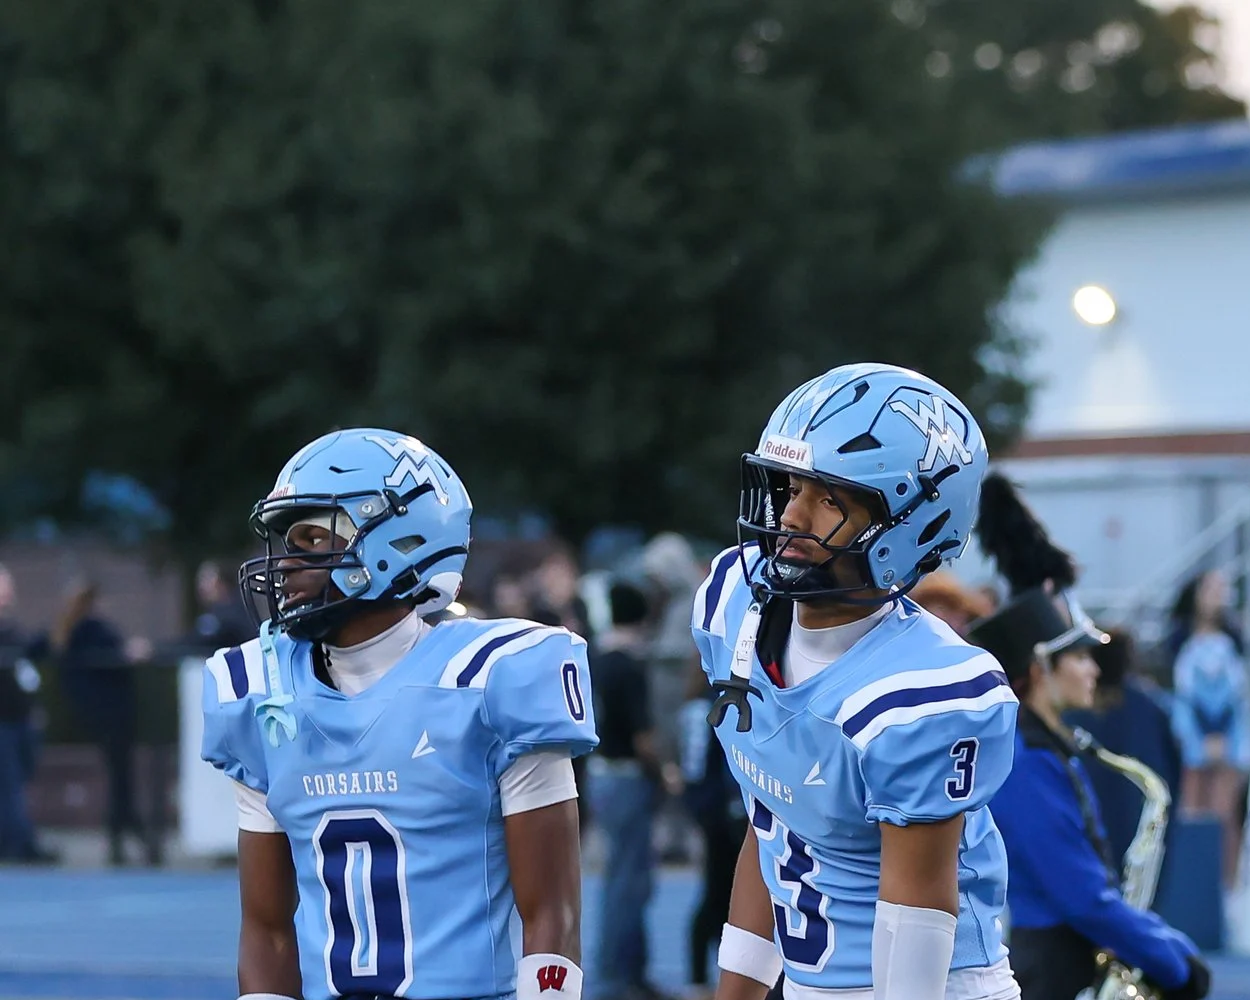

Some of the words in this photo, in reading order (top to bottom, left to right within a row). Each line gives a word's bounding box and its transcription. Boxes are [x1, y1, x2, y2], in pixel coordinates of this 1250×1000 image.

[764, 440, 808, 462] Riddell
[560, 660, 585, 720] 0
[302, 770, 398, 797] CORSAIRS
[731, 743, 793, 804] CORSAIRS
[945, 737, 980, 801] 3
[312, 808, 414, 998] 0
[750, 795, 835, 974] 3
[536, 964, 568, 993] W
